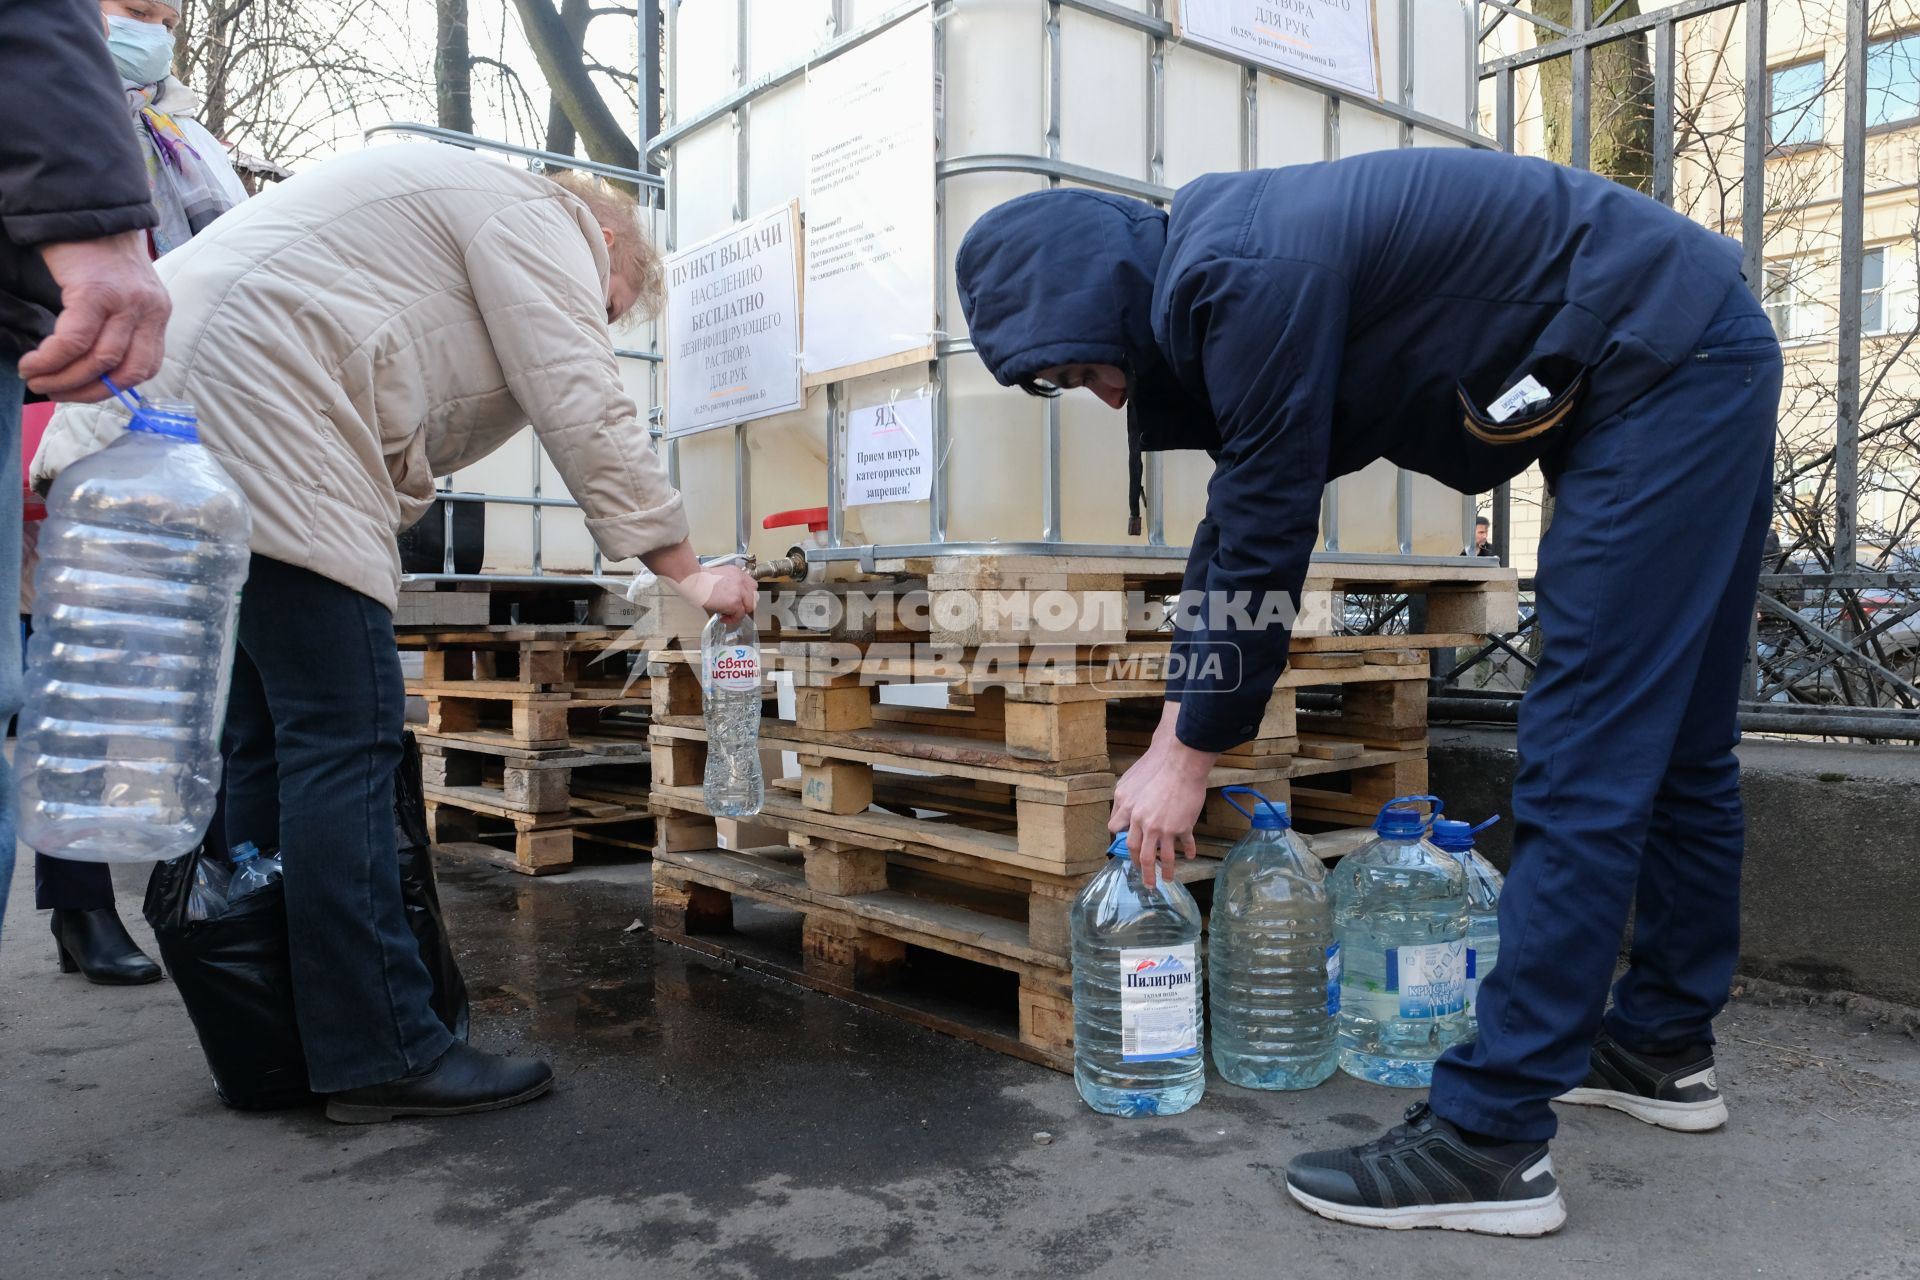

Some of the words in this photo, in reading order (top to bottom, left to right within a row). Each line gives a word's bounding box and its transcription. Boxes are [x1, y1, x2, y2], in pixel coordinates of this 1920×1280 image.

[1255, 7, 1281, 27] ДЛЯ
[1285, 17, 1311, 39] РУК
[1230, 25, 1256, 41] (0,25%
[1258, 36, 1287, 53] раствор
[1289, 48, 1327, 66] хлорамина
[672, 251, 717, 288] ПУНКТ
[720, 223, 783, 268] ВЫДАЧИ
[691, 264, 763, 306] НАСЕЛЕНИЮ
[692, 291, 764, 332] БЕСПЛАТНО
[680, 312, 781, 359] ДЕЗИНФИЦИРУЮЩЕГО
[705, 344, 751, 370] РАСТВОРА
[709, 370, 728, 392] ДЛЯ
[730, 366, 748, 386] РУК
[875, 405, 897, 429] ЯД
[857, 451, 884, 466] Прием
[887, 447, 920, 462] внутрь
[856, 466, 921, 482] категорически
[866, 482, 911, 500] запрещен!
[1127, 972, 1191, 989] Пилигрим
[1428, 994, 1454, 1007] АКВА
